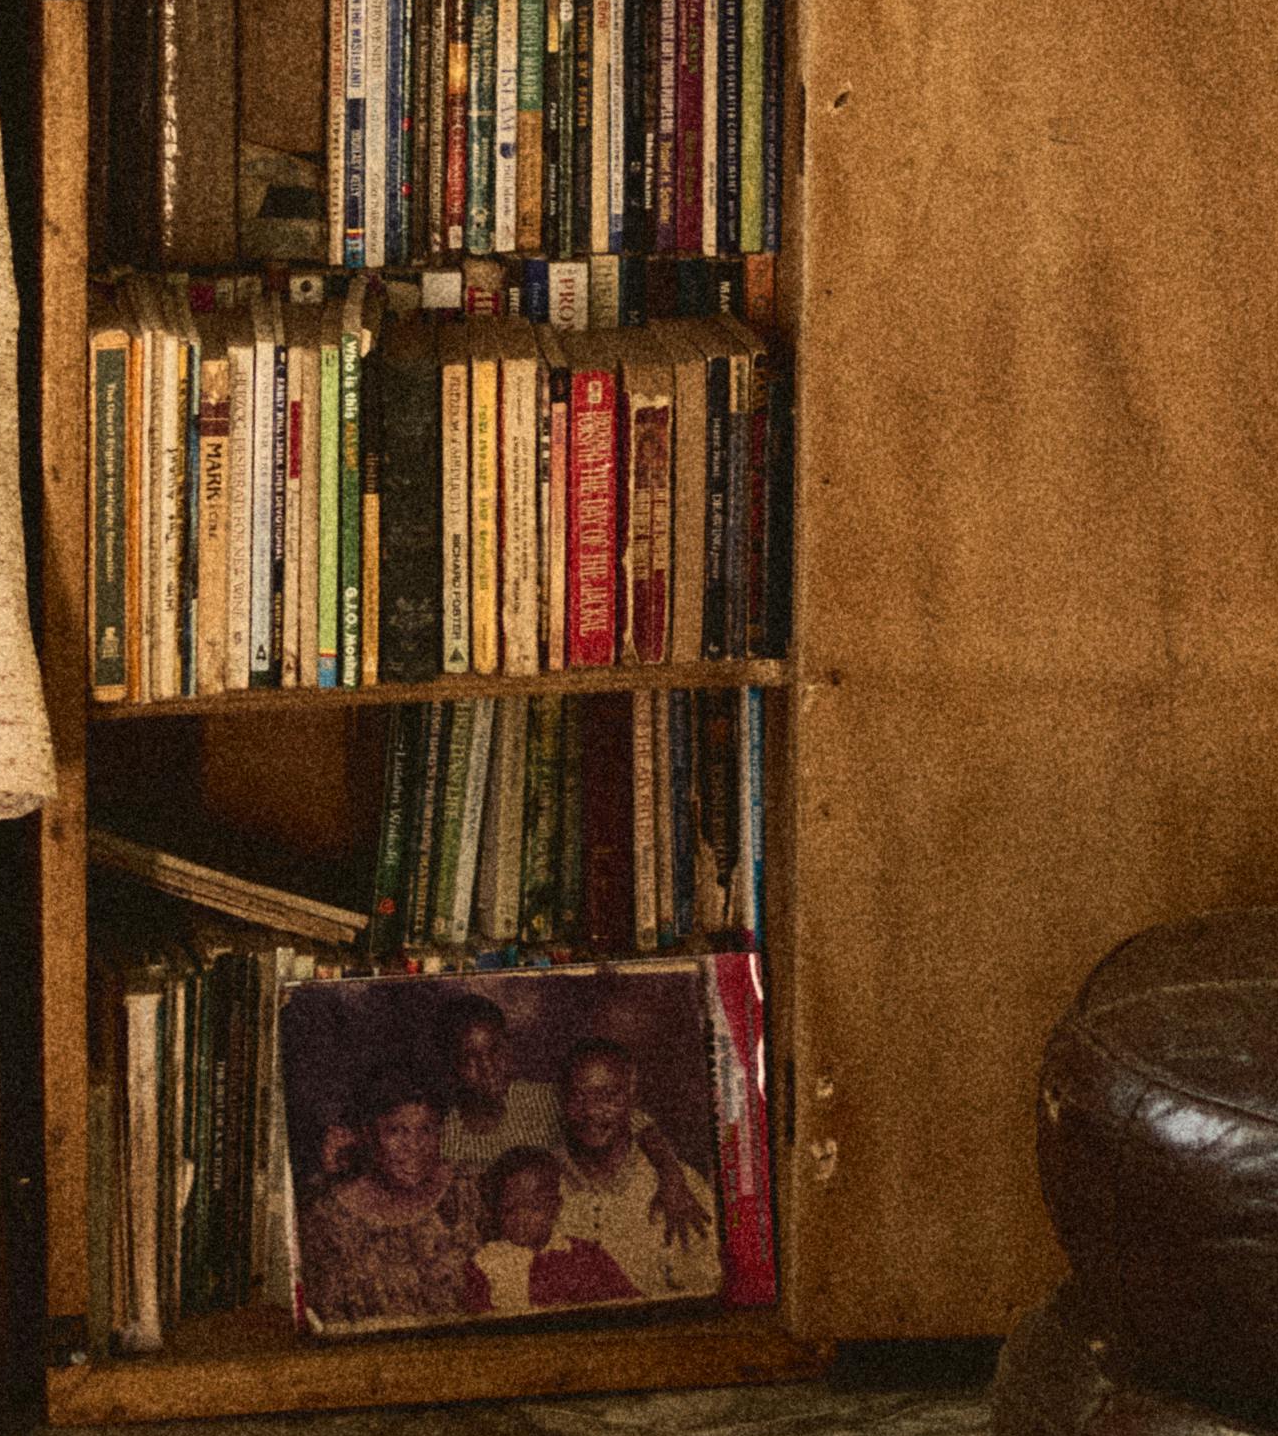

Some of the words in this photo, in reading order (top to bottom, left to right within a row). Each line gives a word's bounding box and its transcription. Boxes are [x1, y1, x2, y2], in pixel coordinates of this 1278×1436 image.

[352, 7, 363, 25] THE
[352, 28, 363, 88] WASTELAND
[343, 341, 358, 373] Who
[344, 376, 357, 388] is
[344, 393, 357, 419] this
[205, 443, 223, 501] MARK
[452, 534, 461, 588] RICHARD
[452, 591, 461, 640] FOSTER
